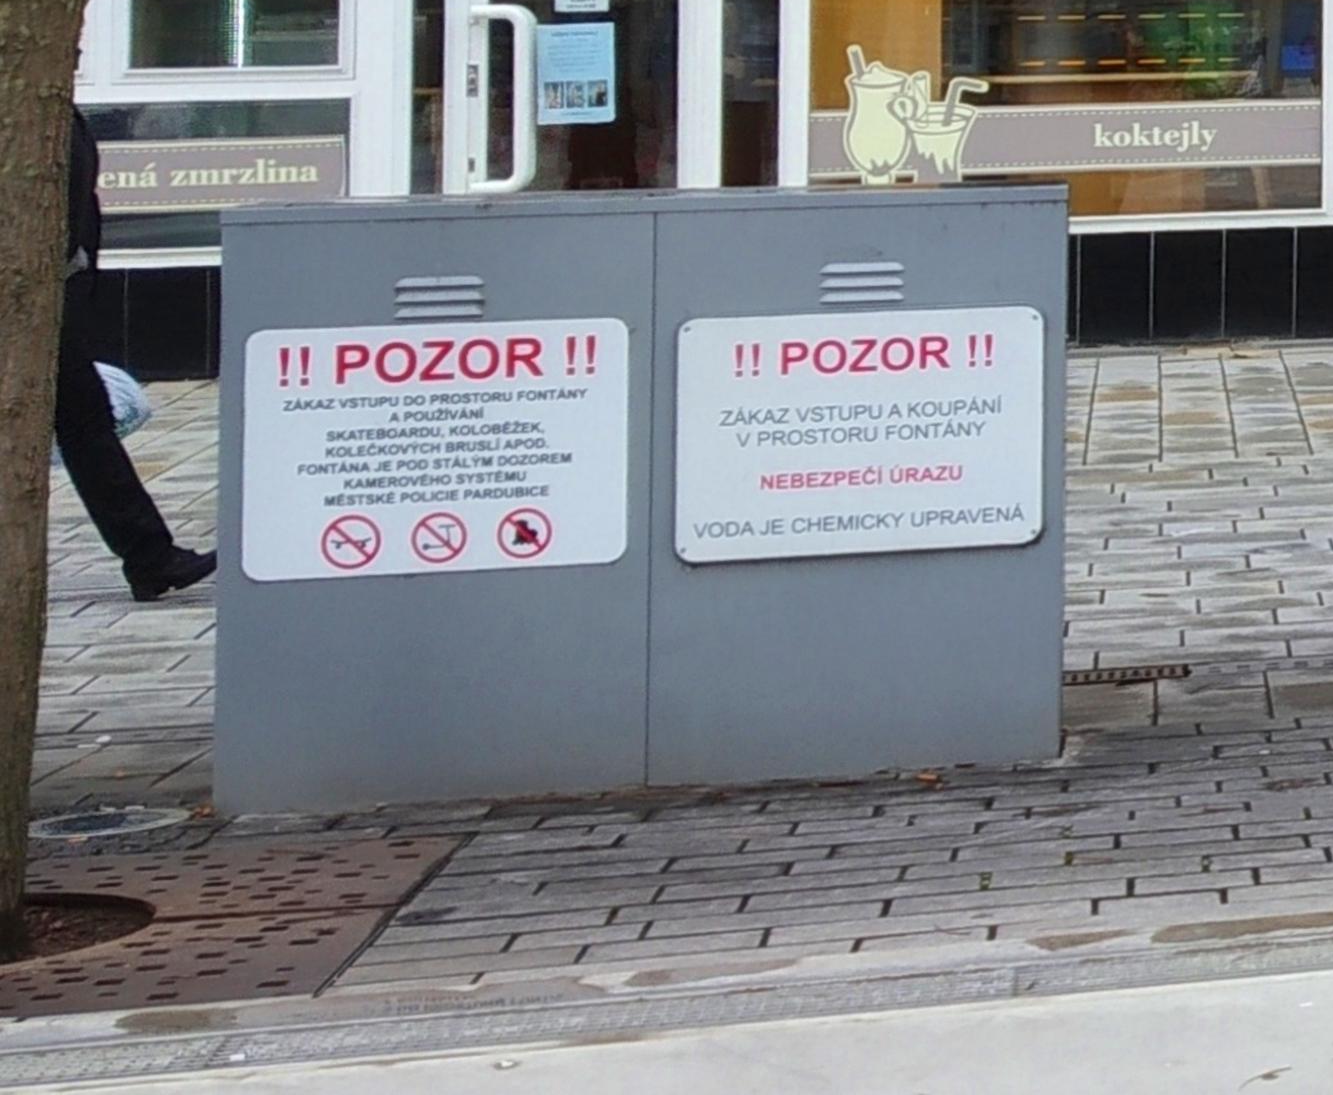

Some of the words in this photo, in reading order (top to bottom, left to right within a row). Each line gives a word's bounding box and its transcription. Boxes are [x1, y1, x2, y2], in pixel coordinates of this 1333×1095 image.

[1093, 120, 1218, 153] koktejly
[97, 162, 158, 189] ená
[169, 158, 319, 187] zmrzlina
[279, 346, 310, 387] !!
[335, 337, 544, 385] POZOR
[566, 335, 596, 376] !!
[735, 343, 760, 377] !!
[780, 335, 950, 375] POZOR
[968, 334, 993, 367] !!
[283, 397, 335, 412] ZÁKAZ
[338, 395, 400, 409] VSTUPU
[403, 394, 426, 406] DO
[430, 391, 513, 405] PROSTORU
[517, 387, 588, 402] FONTÁNY
[719, 406, 790, 426] ZÁKAZ
[796, 403, 883, 423] VSTUPU
[887, 401, 903, 419] A
[907, 395, 1002, 418] KOUPÁNÍ
[388, 411, 400, 423] A
[403, 406, 485, 422] POUŽÍVÁNÍ
[326, 426, 445, 442] SKATEBOARDU,
[449, 420, 545, 437] KOLOBĚŽEK,
[736, 432, 751, 448] V
[757, 426, 878, 447] PROSTORU
[885, 420, 986, 440] FONTÁNY
[325, 441, 441, 458] KOLEČKOVÝCH
[445, 438, 500, 453] BRUSLÍ
[503, 437, 549, 450] APOD.
[297, 460, 370, 475] FONTÁNA
[374, 460, 392, 472] JE
[396, 459, 429, 471] POD
[432, 455, 493, 470] STÁLÝM
[497, 452, 573, 467] DOZOREM
[344, 472, 452, 489] KAMEROVÉHO
[455, 469, 528, 485] SYSTÉMU
[760, 466, 883, 490] NEBEZPEČÍ
[890, 464, 963, 484] ÚRAZU
[323, 491, 396, 507] MĚSTSKÉ
[400, 489, 459, 503] POLICIE
[463, 484, 550, 501] PARDUBICE
[693, 520, 755, 539] VODA
[760, 519, 785, 536] JE
[791, 512, 905, 534] CHEMICKY
[911, 502, 1025, 528] UPRAVENÁ
